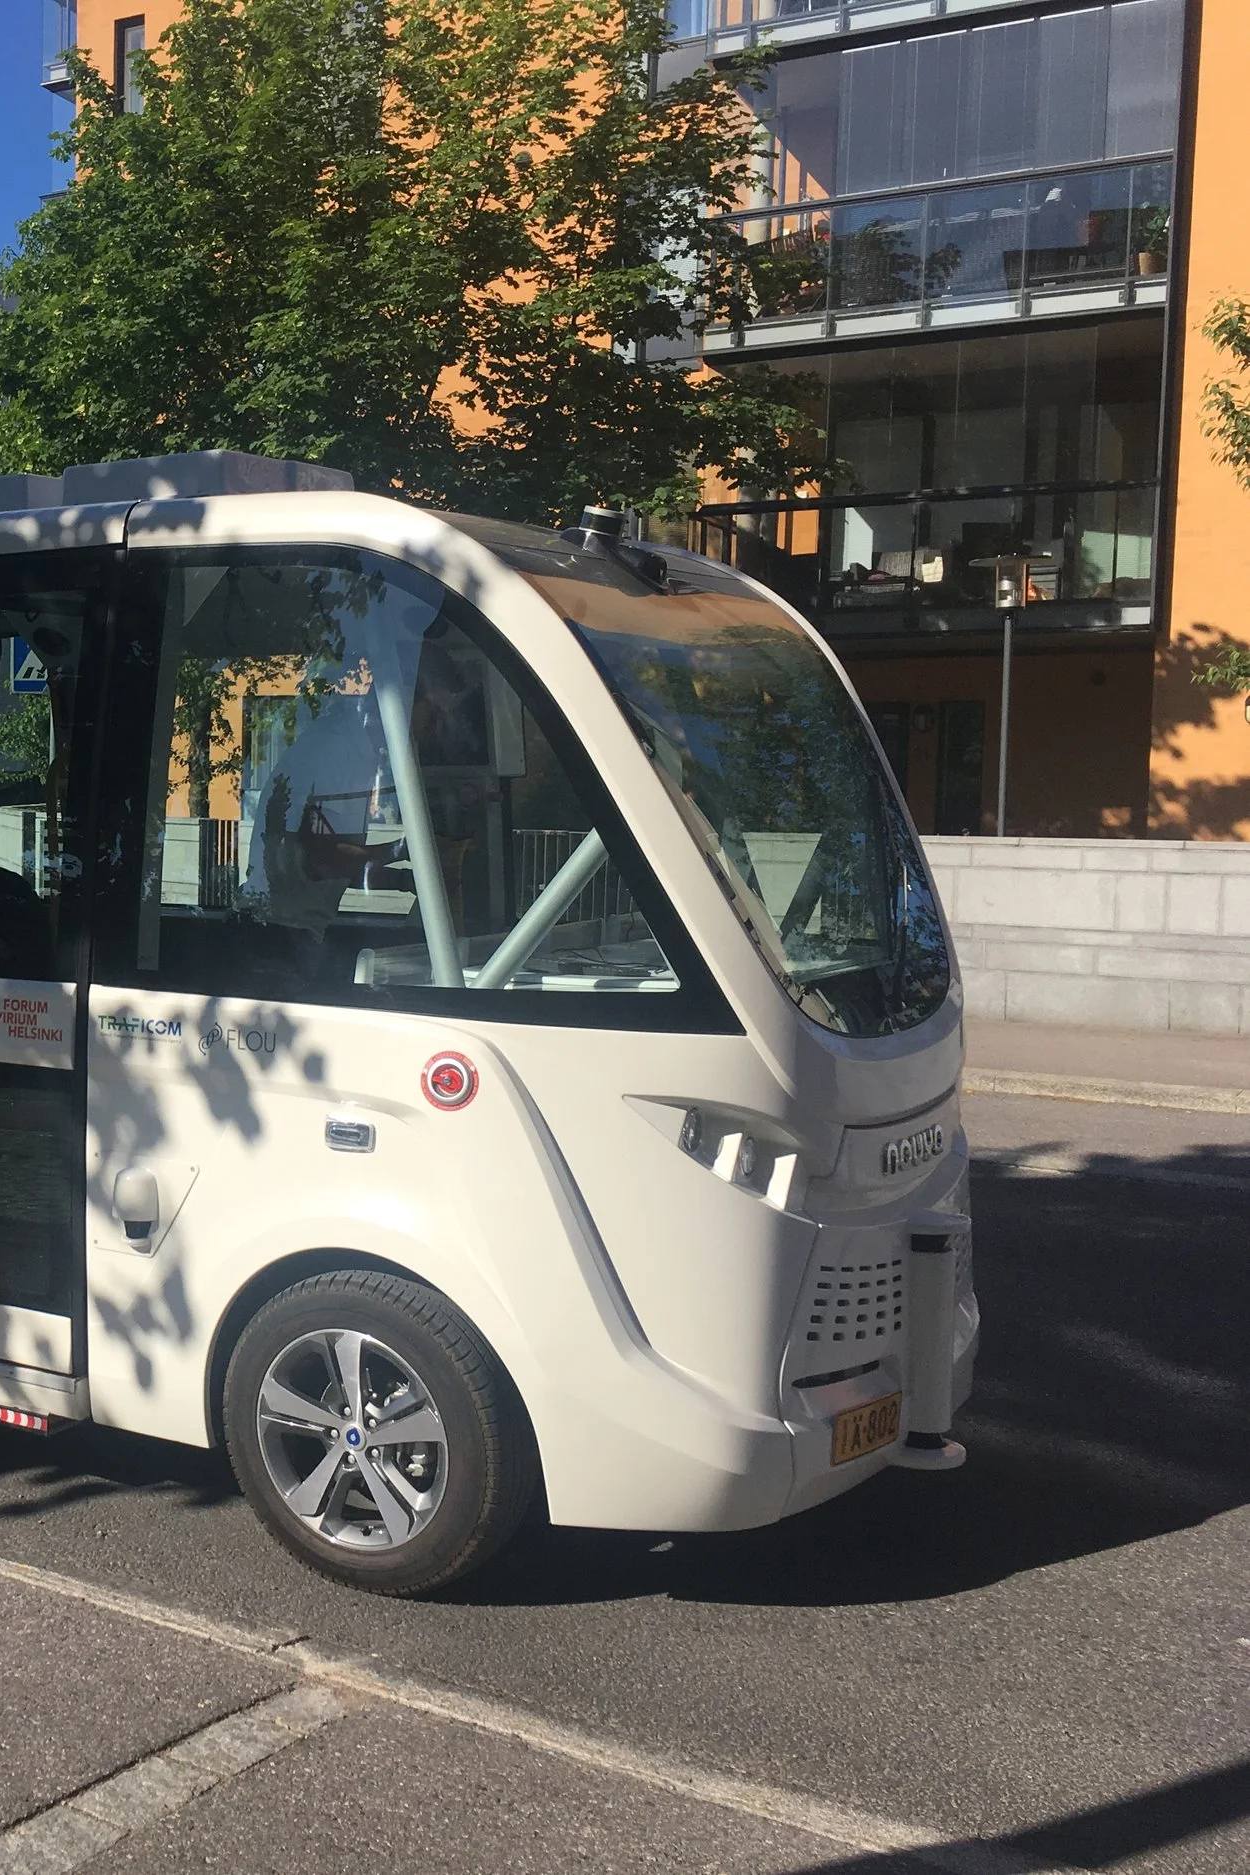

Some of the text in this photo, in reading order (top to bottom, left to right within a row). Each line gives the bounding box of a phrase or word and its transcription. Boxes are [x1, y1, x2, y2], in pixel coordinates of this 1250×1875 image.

[3, 998, 48, 1014] FORUM
[8, 1026, 63, 1042] HELSINKI
[98, 1015, 182, 1037] TRAFICOM
[226, 1028, 276, 1053] FLOU
